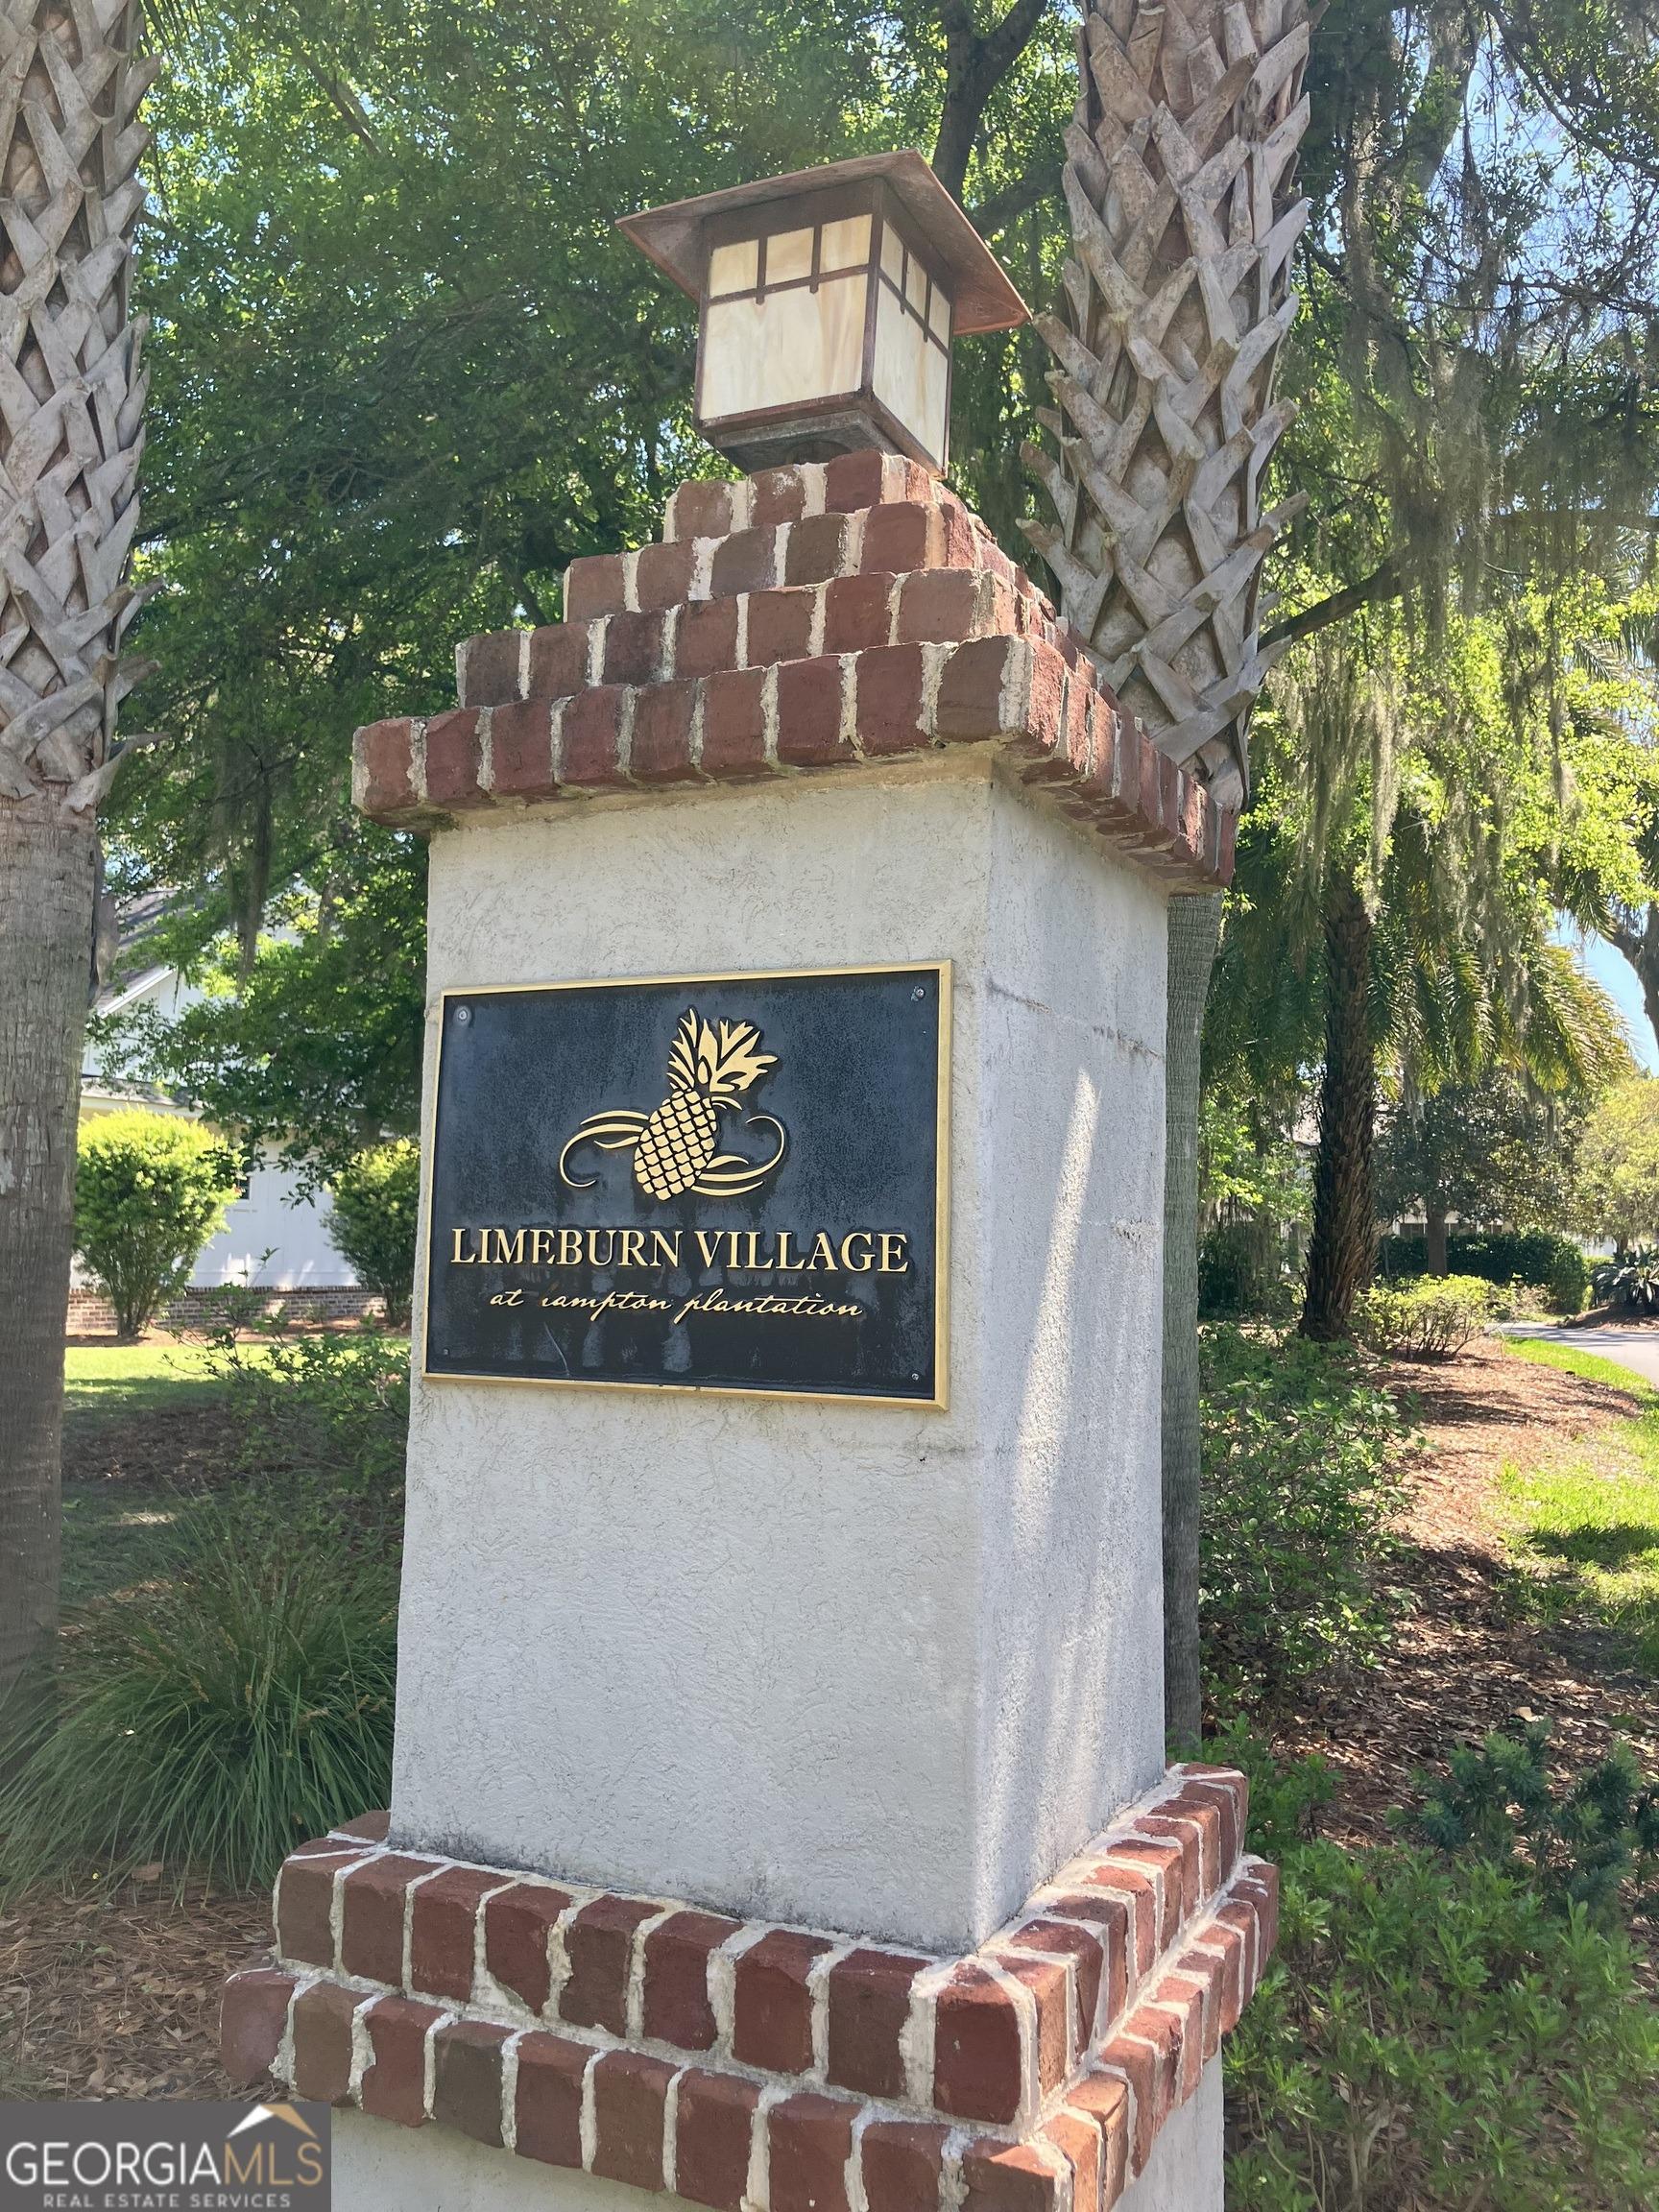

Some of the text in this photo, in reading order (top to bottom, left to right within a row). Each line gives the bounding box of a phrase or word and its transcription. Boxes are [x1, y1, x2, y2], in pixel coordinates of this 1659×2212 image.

[450, 1228, 909, 1273] LIMEBURN VILLAGE
[490, 1289, 523, 1307] at
[674, 1288, 863, 1325] plantation
